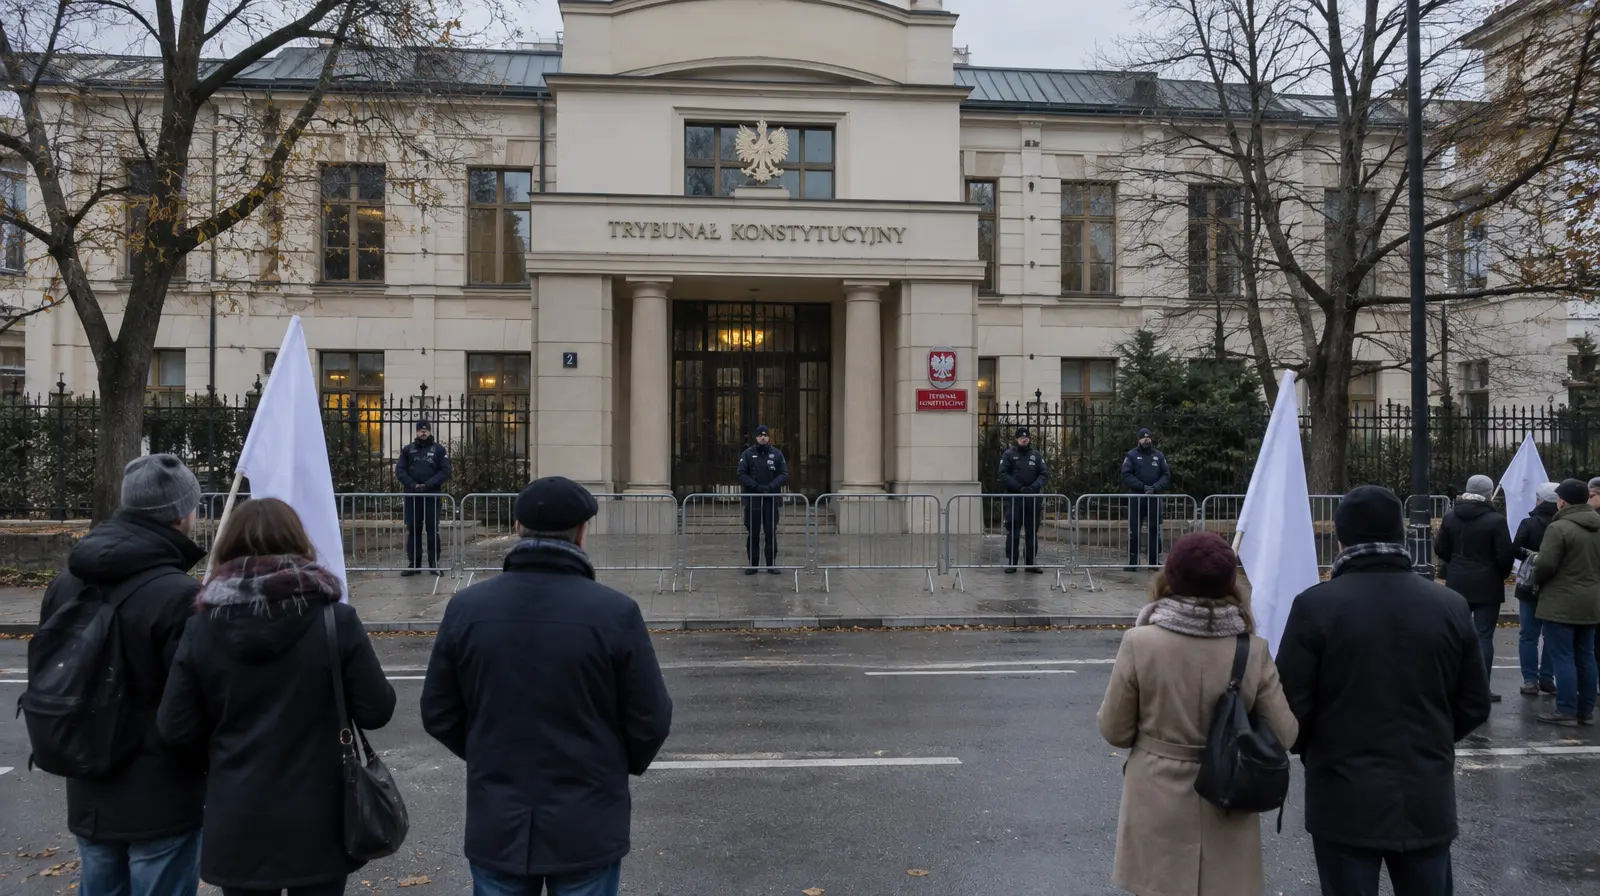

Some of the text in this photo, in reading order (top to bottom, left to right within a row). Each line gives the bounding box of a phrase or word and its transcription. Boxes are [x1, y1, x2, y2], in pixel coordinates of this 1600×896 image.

[607, 221, 907, 245] TRYBUNAŁ KONSTYTUCYJNY
[566, 354, 573, 365] 2
